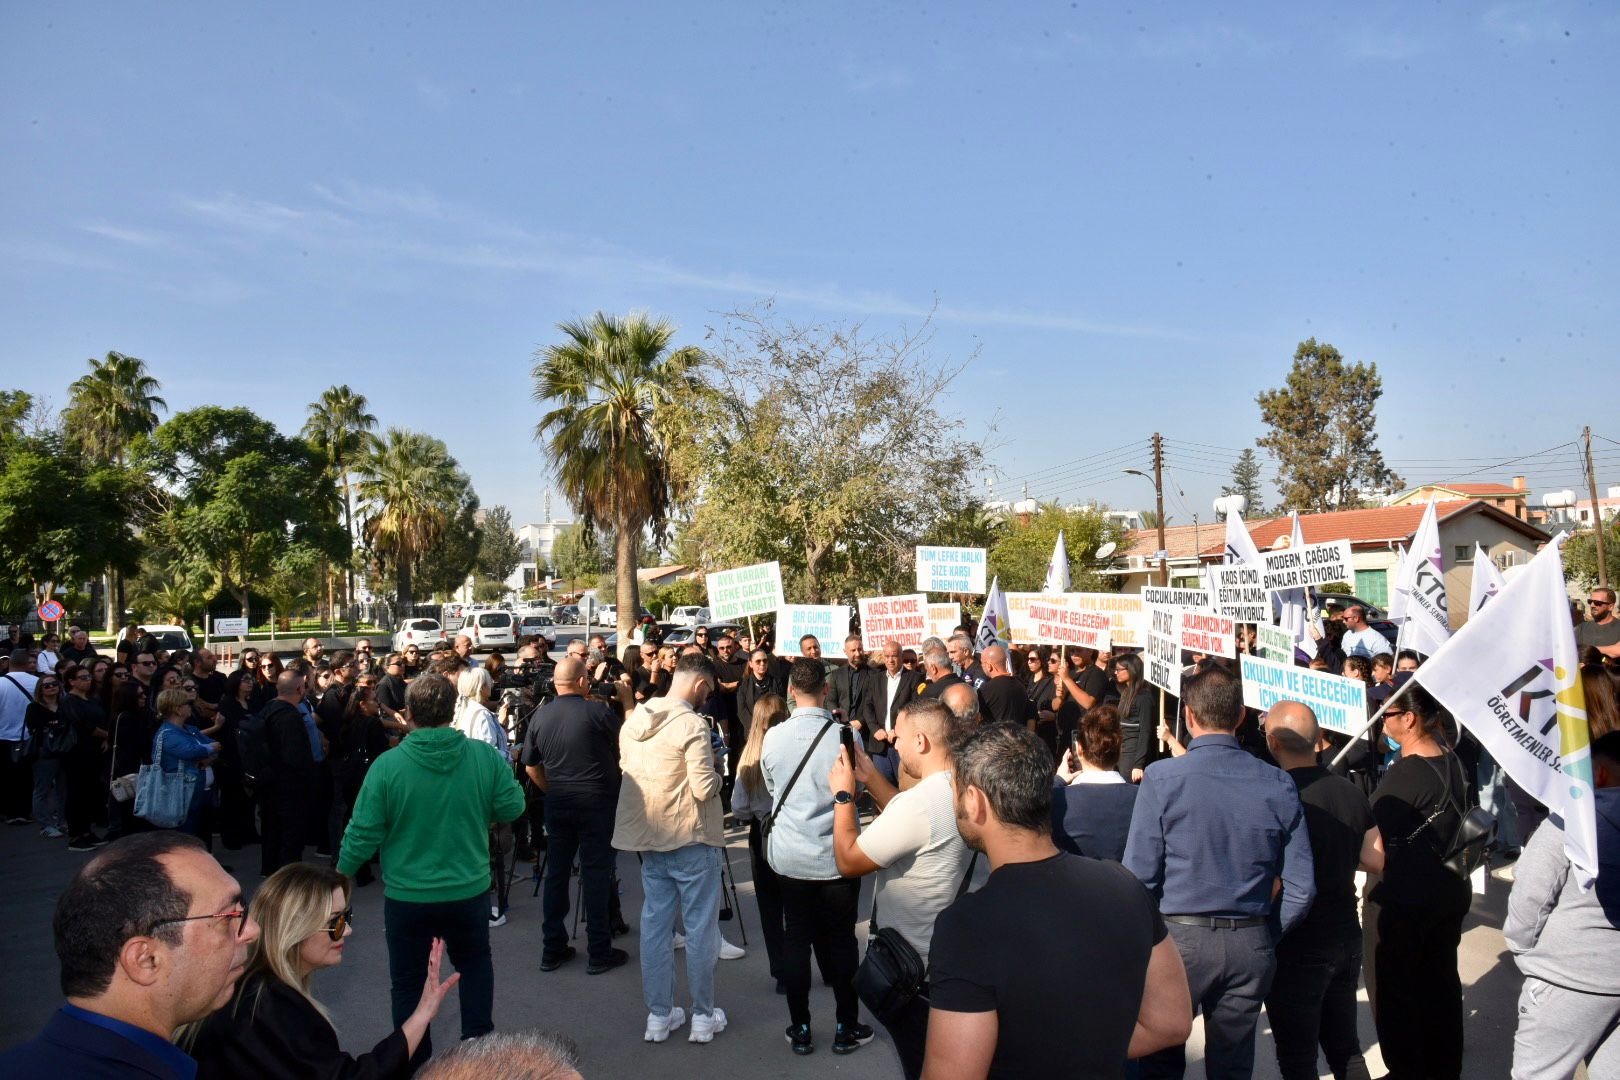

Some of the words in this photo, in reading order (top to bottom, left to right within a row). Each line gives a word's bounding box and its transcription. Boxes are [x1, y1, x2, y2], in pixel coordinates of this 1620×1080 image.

[1221, 570, 1238, 585] KAOS
[1264, 571, 1298, 589] BİNALAR
[1299, 564, 1349, 584] İSTİYORUZ.
[1243, 588, 1267, 602] ALMAK
[868, 602, 889, 615] KAOS
[1029, 605, 1057, 623] OKULUM
[1060, 610, 1068, 624] VE
[895, 615, 924, 631] ALMAK
[1243, 661, 1284, 689] OKULUM
[1286, 671, 1300, 692] VE
[1301, 675, 1363, 708] GELECEĞİM
[1487, 695, 1552, 763] ÖĞRETMENLER
